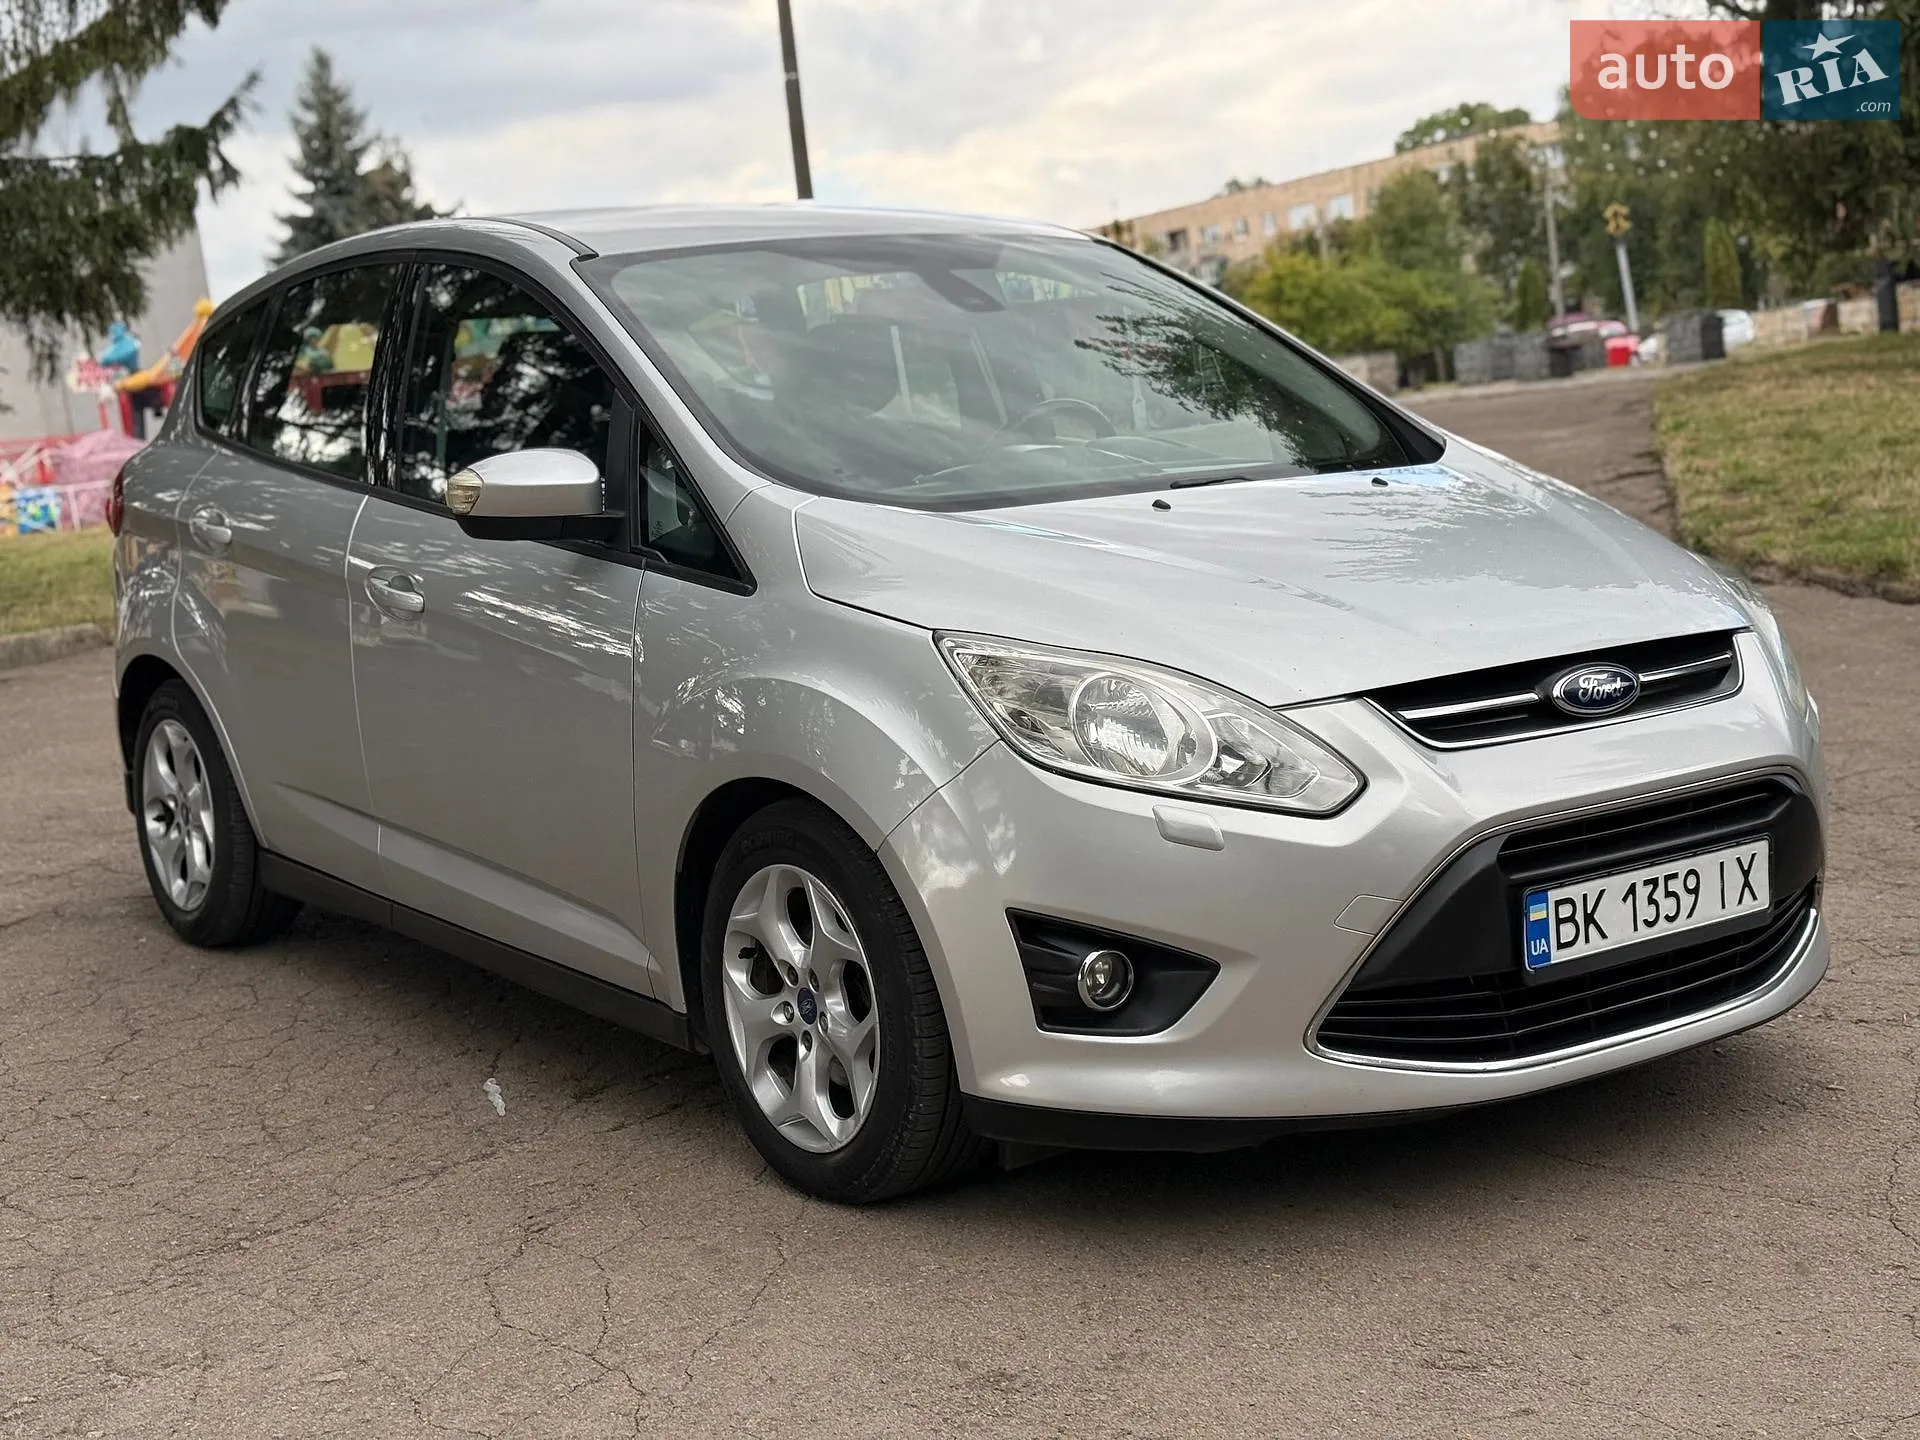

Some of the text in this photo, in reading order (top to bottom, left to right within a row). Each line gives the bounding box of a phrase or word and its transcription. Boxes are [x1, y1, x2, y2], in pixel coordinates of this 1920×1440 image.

[1578, 673, 1624, 703] Ford
[1554, 888, 1608, 950] BK
[1621, 868, 1701, 932] 1359
[1531, 937, 1549, 956] UA
